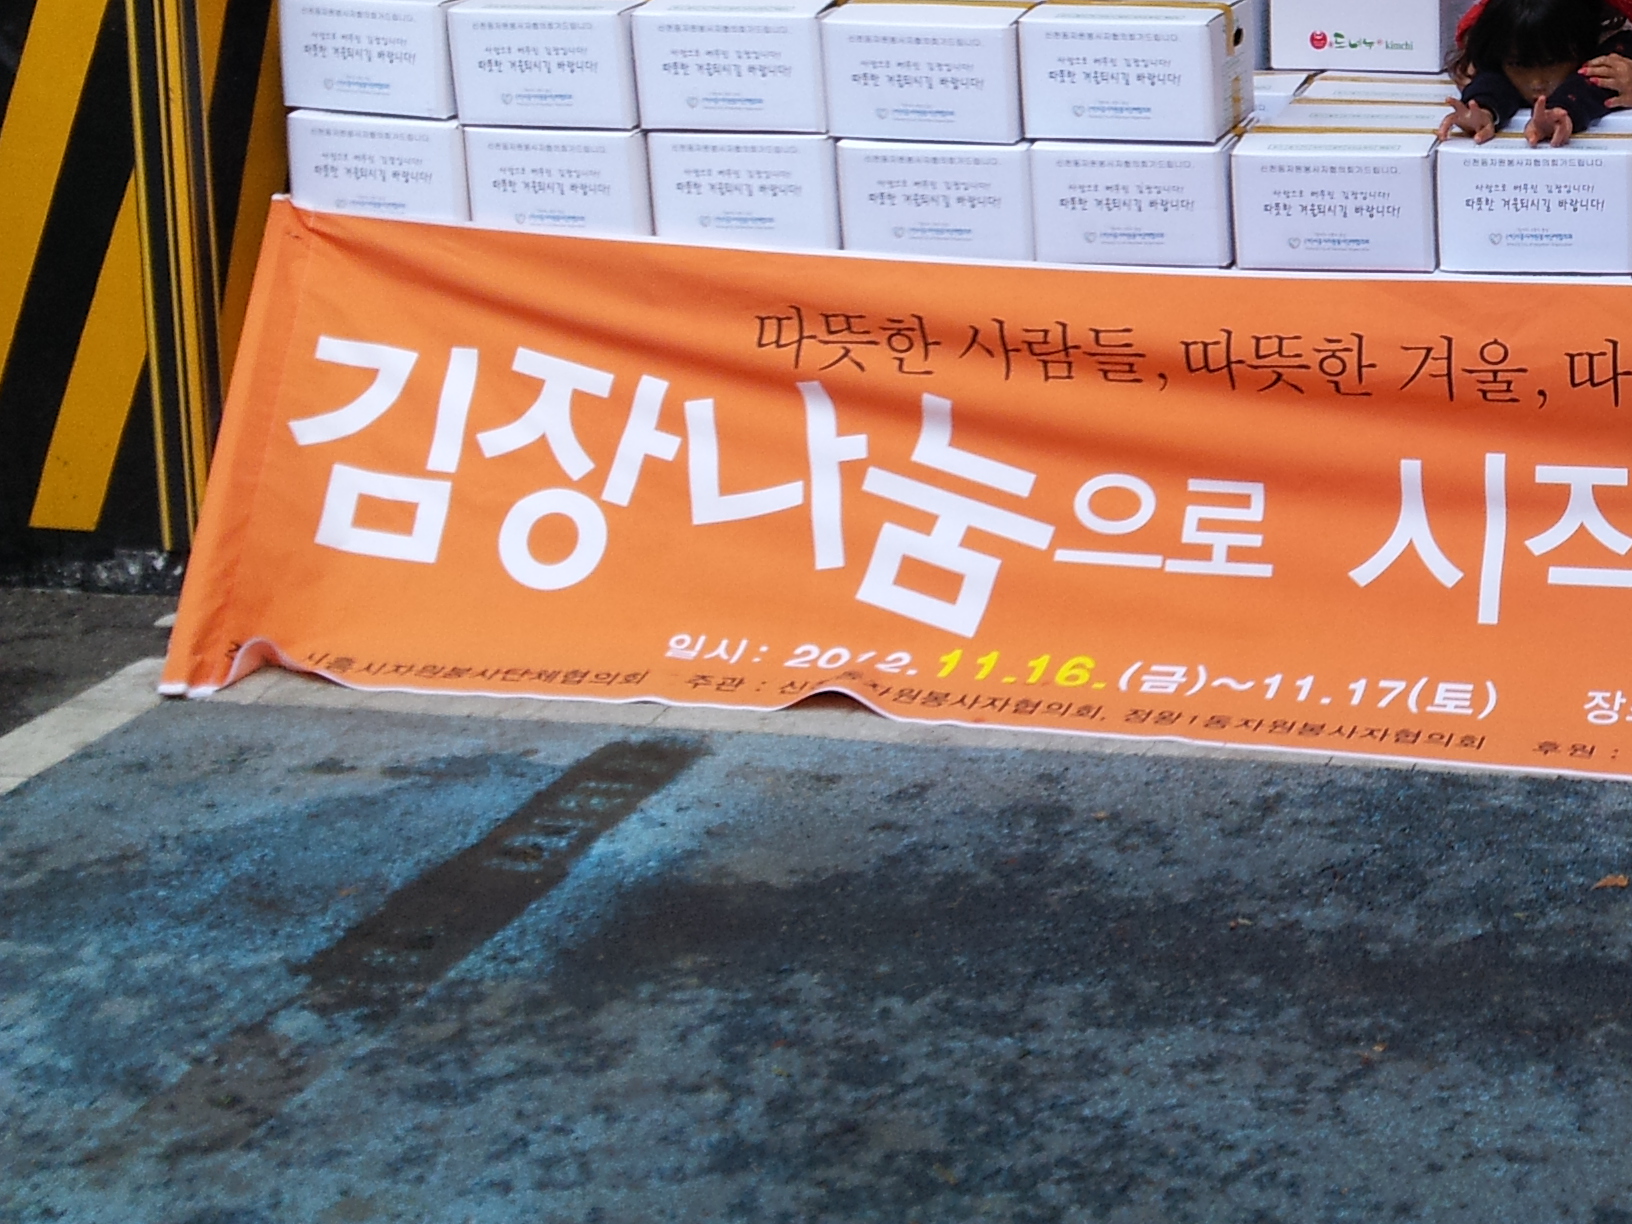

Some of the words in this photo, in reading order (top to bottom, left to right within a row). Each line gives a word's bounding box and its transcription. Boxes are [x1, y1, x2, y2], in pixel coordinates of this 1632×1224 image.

[1385, 38, 1414, 51] kimchi
[1464, 197, 1495, 211] 따뜻한
[1500, 198, 1551, 212] 겨울되시길
[1557, 199, 1605, 212] 바랍니다!
[755, 305, 941, 375] 따뜻한
[957, 317, 1169, 392] 사람들,
[1182, 329, 1378, 398] 따뜻한
[1399, 335, 1548, 409] 겨울,
[288, 335, 1274, 638] 김장나눔으로
[665, 633, 768, 665] 일시:
[1533, 740, 1596, 759] 후원
